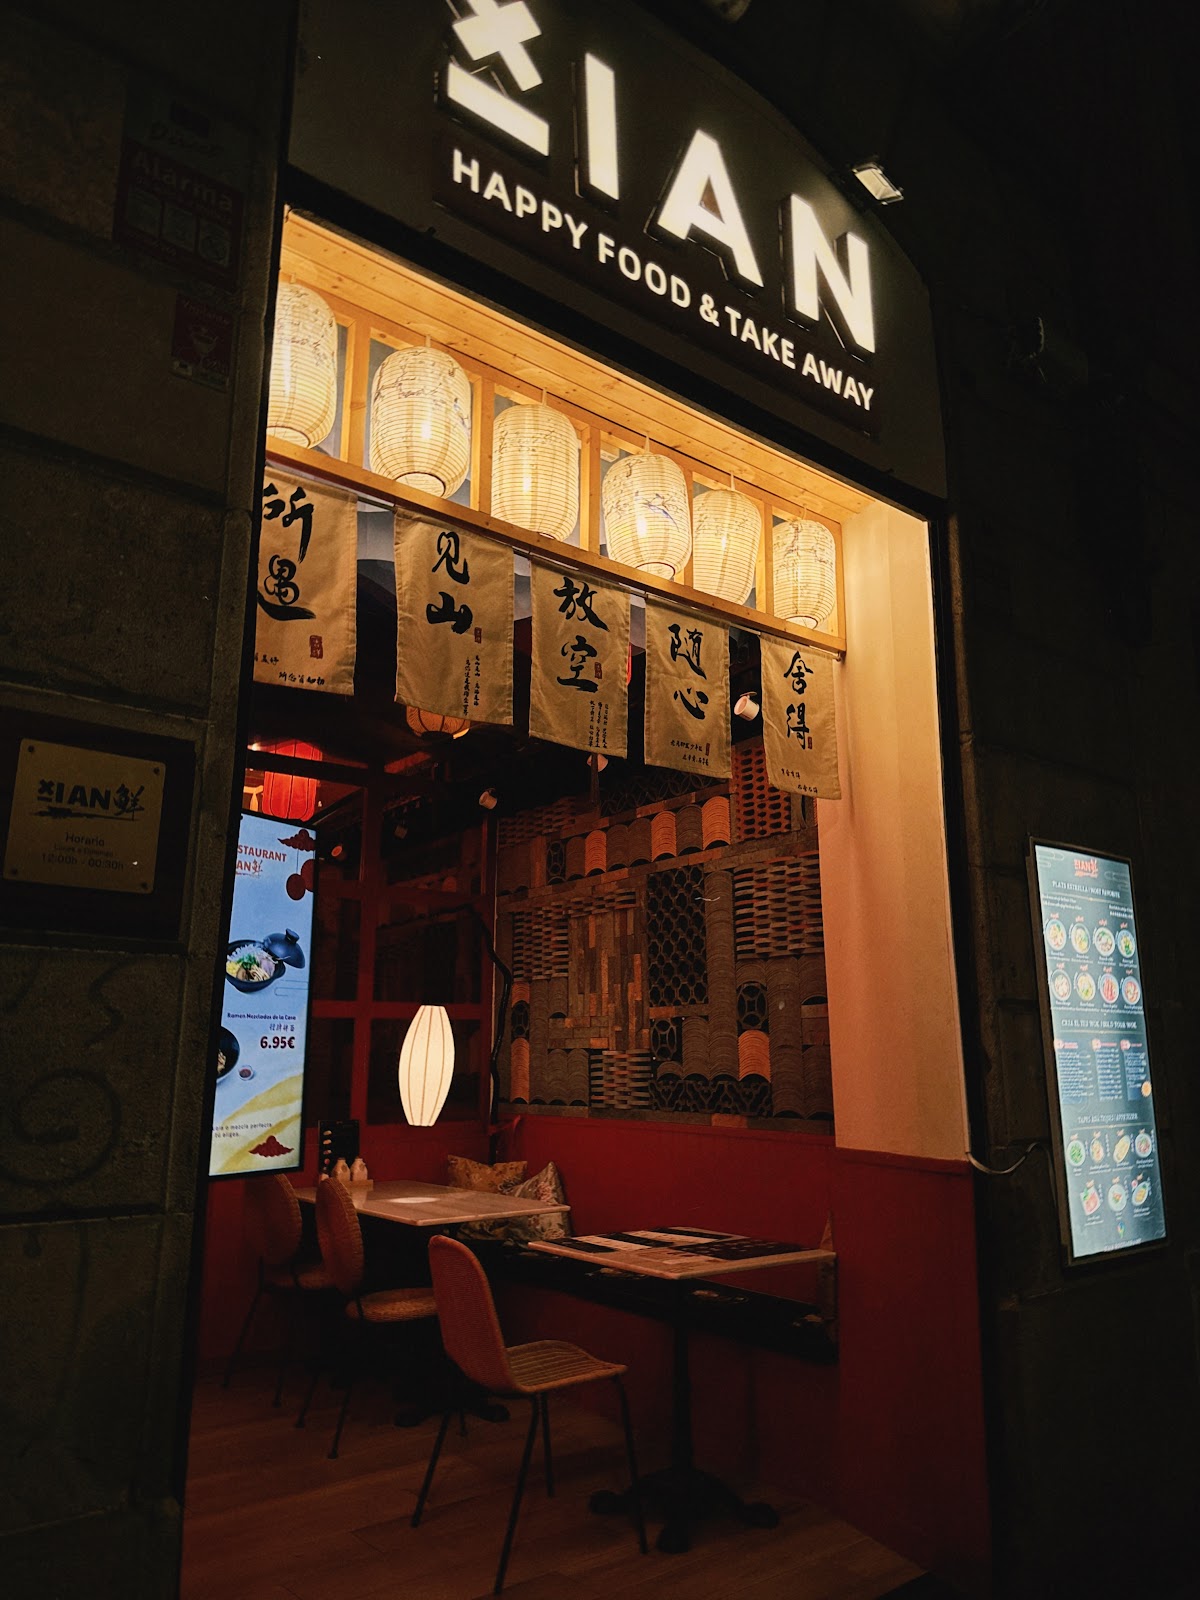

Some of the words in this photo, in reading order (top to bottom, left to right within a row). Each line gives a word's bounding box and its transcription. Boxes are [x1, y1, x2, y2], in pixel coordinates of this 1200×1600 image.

[133, 151, 232, 214] Alarma
[452, 148, 589, 250] HAPPY
[598, 232, 692, 308] FOOD
[699, 293, 720, 328] &
[724, 305, 796, 369] TAKE
[801, 356, 876, 412] AWAY
[257, 482, 317, 622] 所遇
[426, 531, 474, 636] 见山
[552, 576, 610, 694] 放空
[666, 623, 710, 721] 随心
[782, 650, 814, 751] 舍得
[37, 778, 112, 810] XIAN
[65, 831, 105, 847] Horario
[260, 1035, 296, 1049] 6.95€
